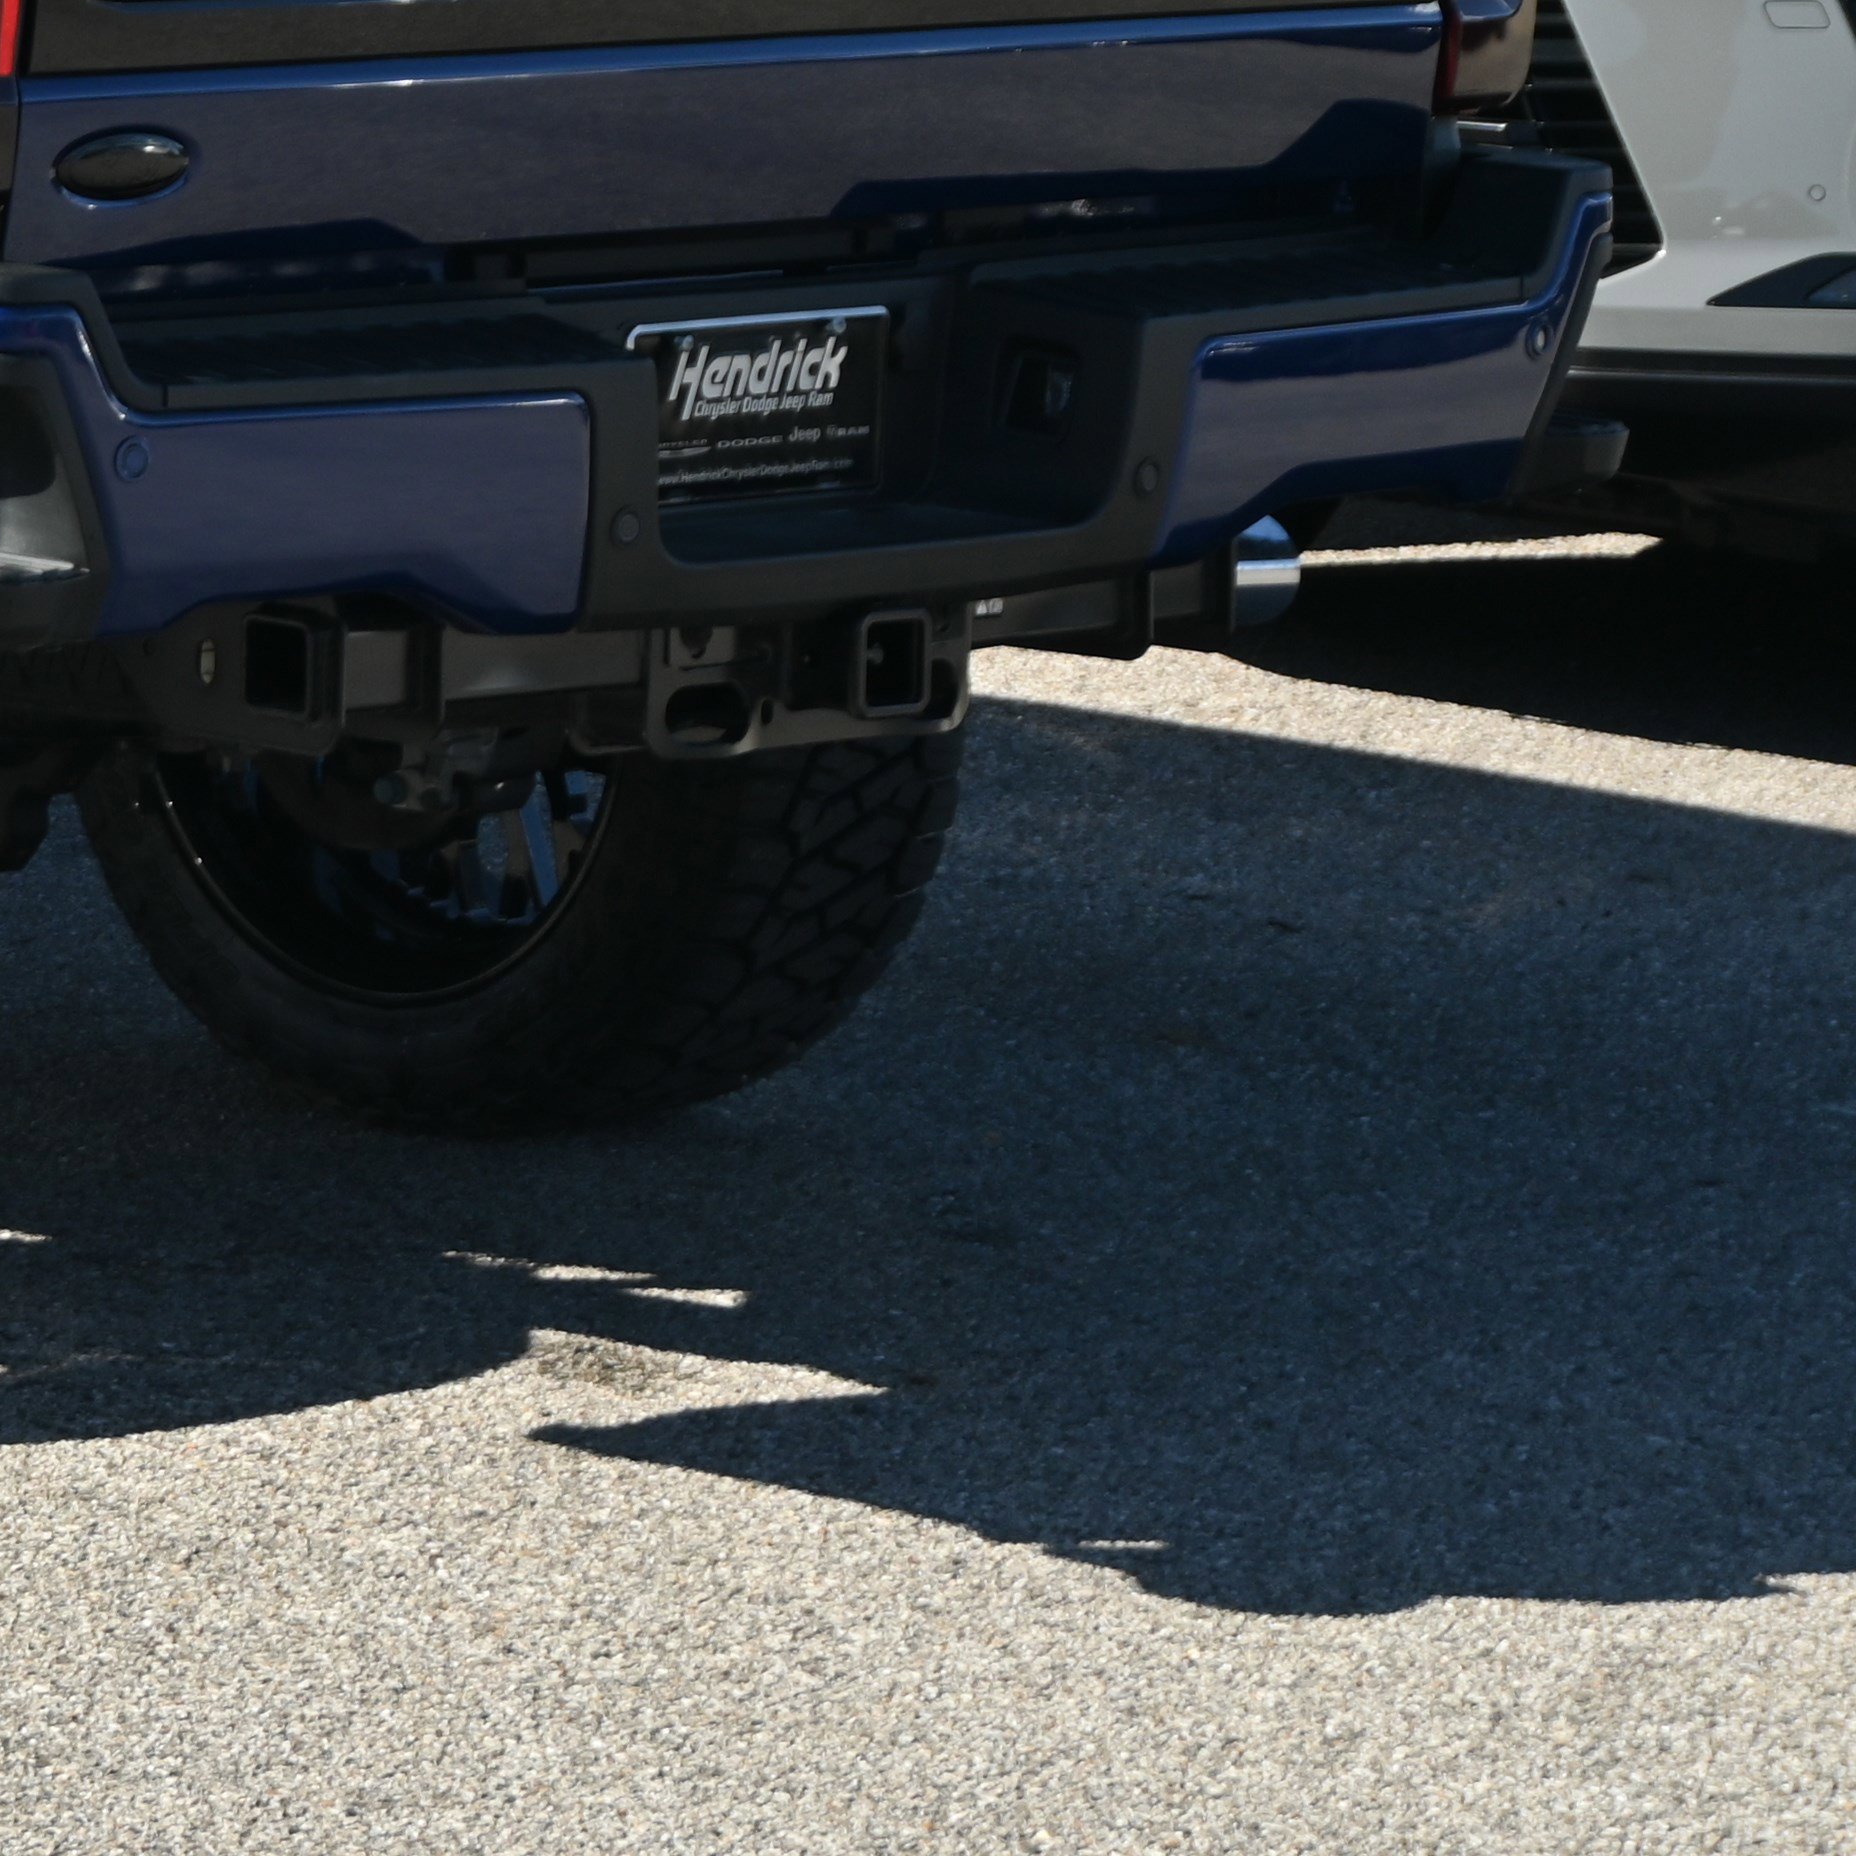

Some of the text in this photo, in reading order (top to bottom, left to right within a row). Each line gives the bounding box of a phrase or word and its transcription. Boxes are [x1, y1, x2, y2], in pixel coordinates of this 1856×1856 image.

[669, 336, 848, 421] Hendrick
[694, 391, 835, 421] Chrysler Dodge Jeep Ram
[717, 435, 784, 449] DODGE
[789, 425, 821, 442] Jeep
